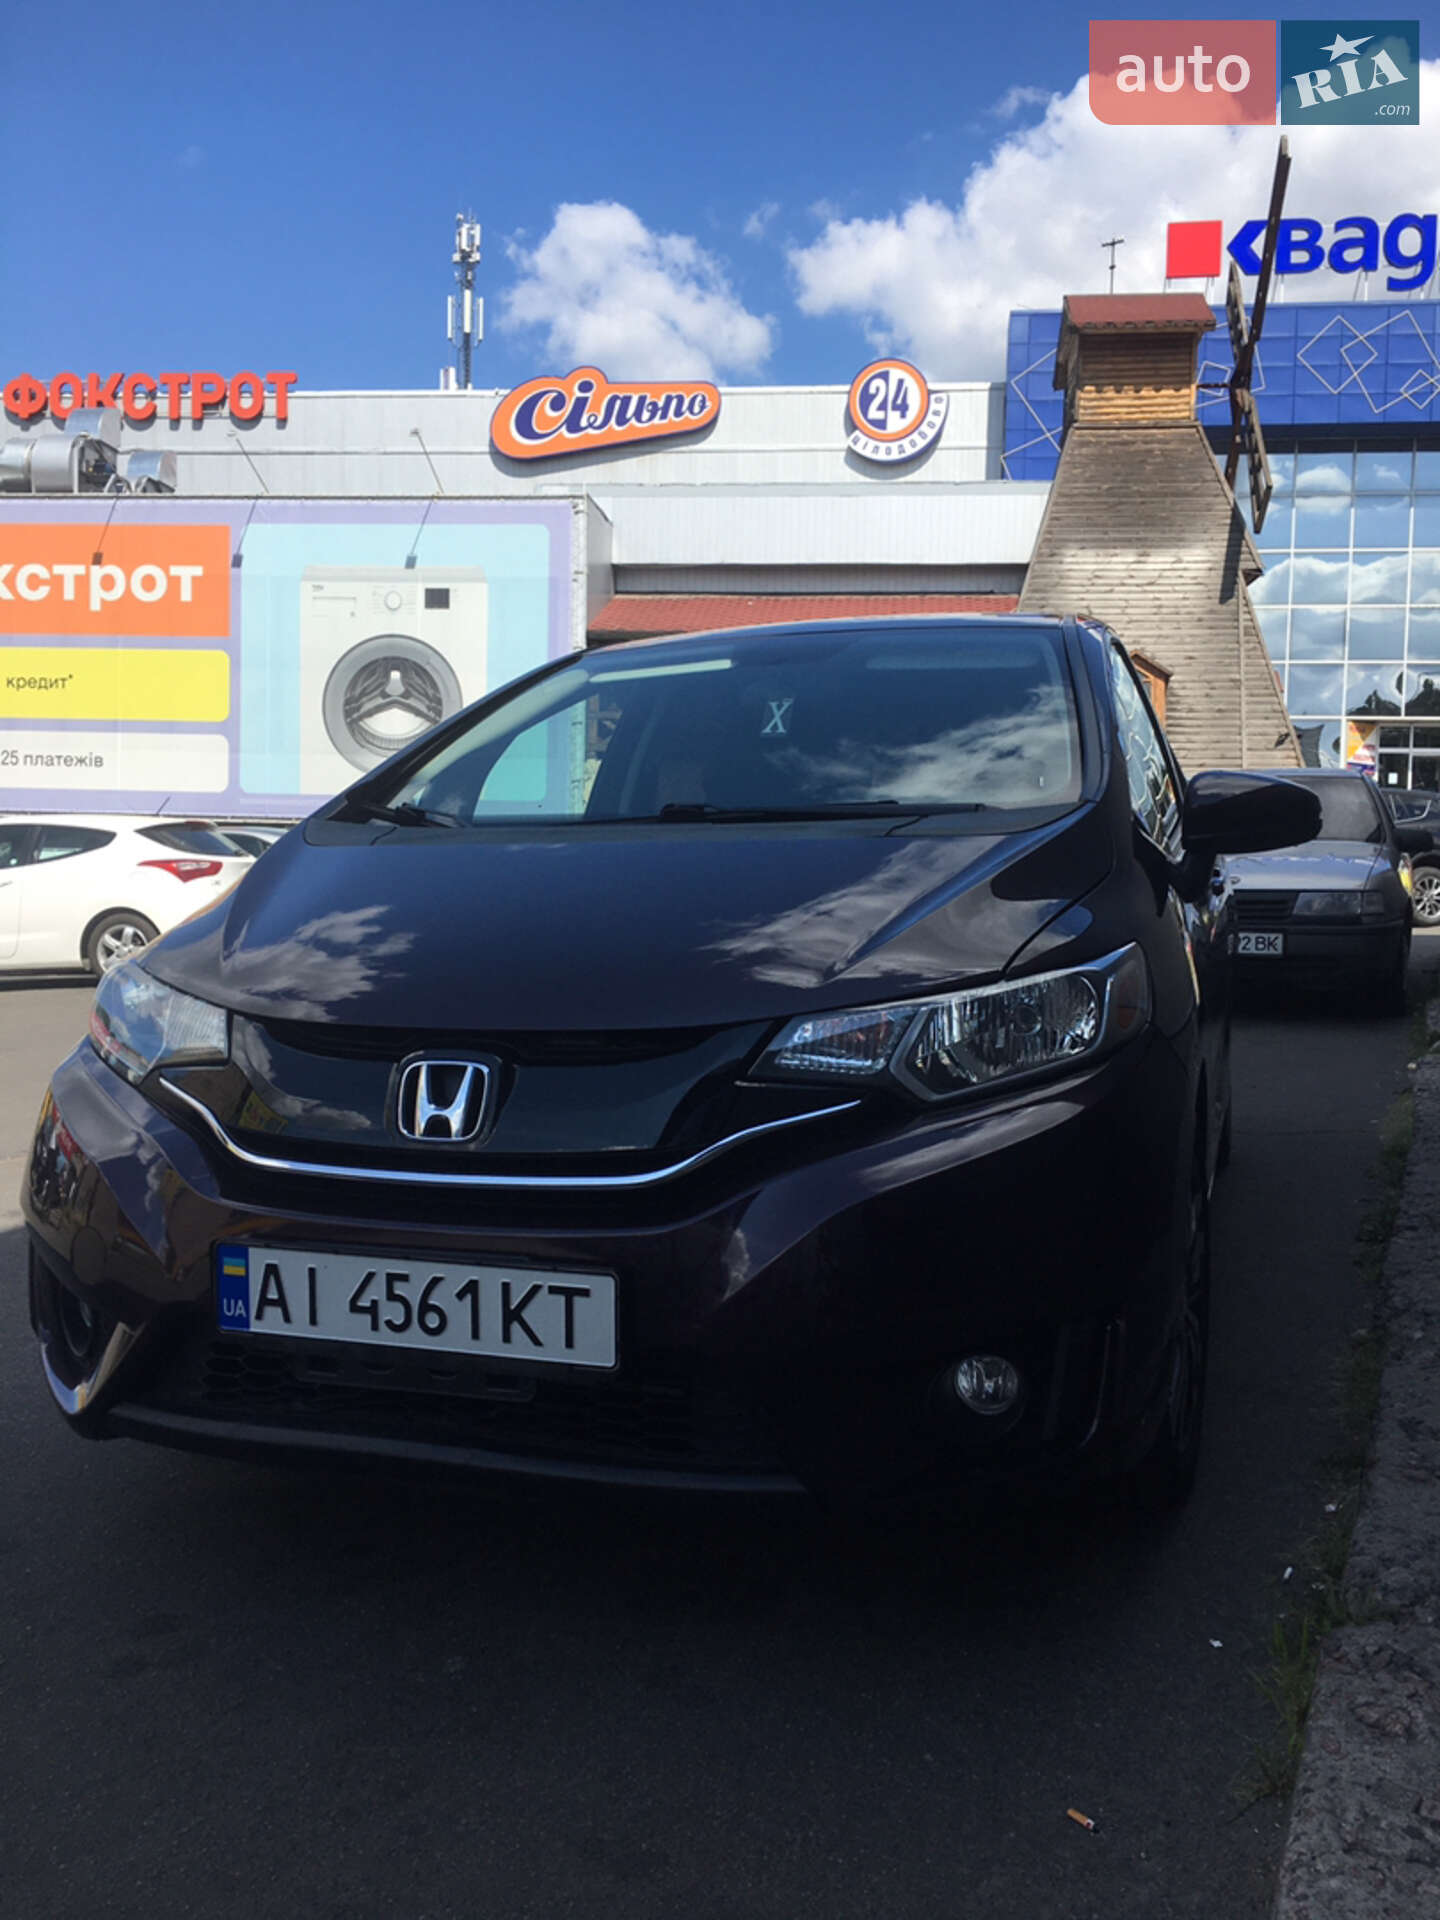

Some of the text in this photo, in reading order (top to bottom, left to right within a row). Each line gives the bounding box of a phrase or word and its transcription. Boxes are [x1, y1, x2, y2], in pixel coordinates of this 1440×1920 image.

[3, 371, 297, 420] ФОКСТРОТ
[515, 380, 709, 440] Сільпо
[867, 377, 909, 420] 24
[0, 749, 105, 768] 25 платежів
[222, 1296, 247, 1319] UA
[348, 1270, 482, 1341] 4561
[502, 1280, 591, 1350] KT
